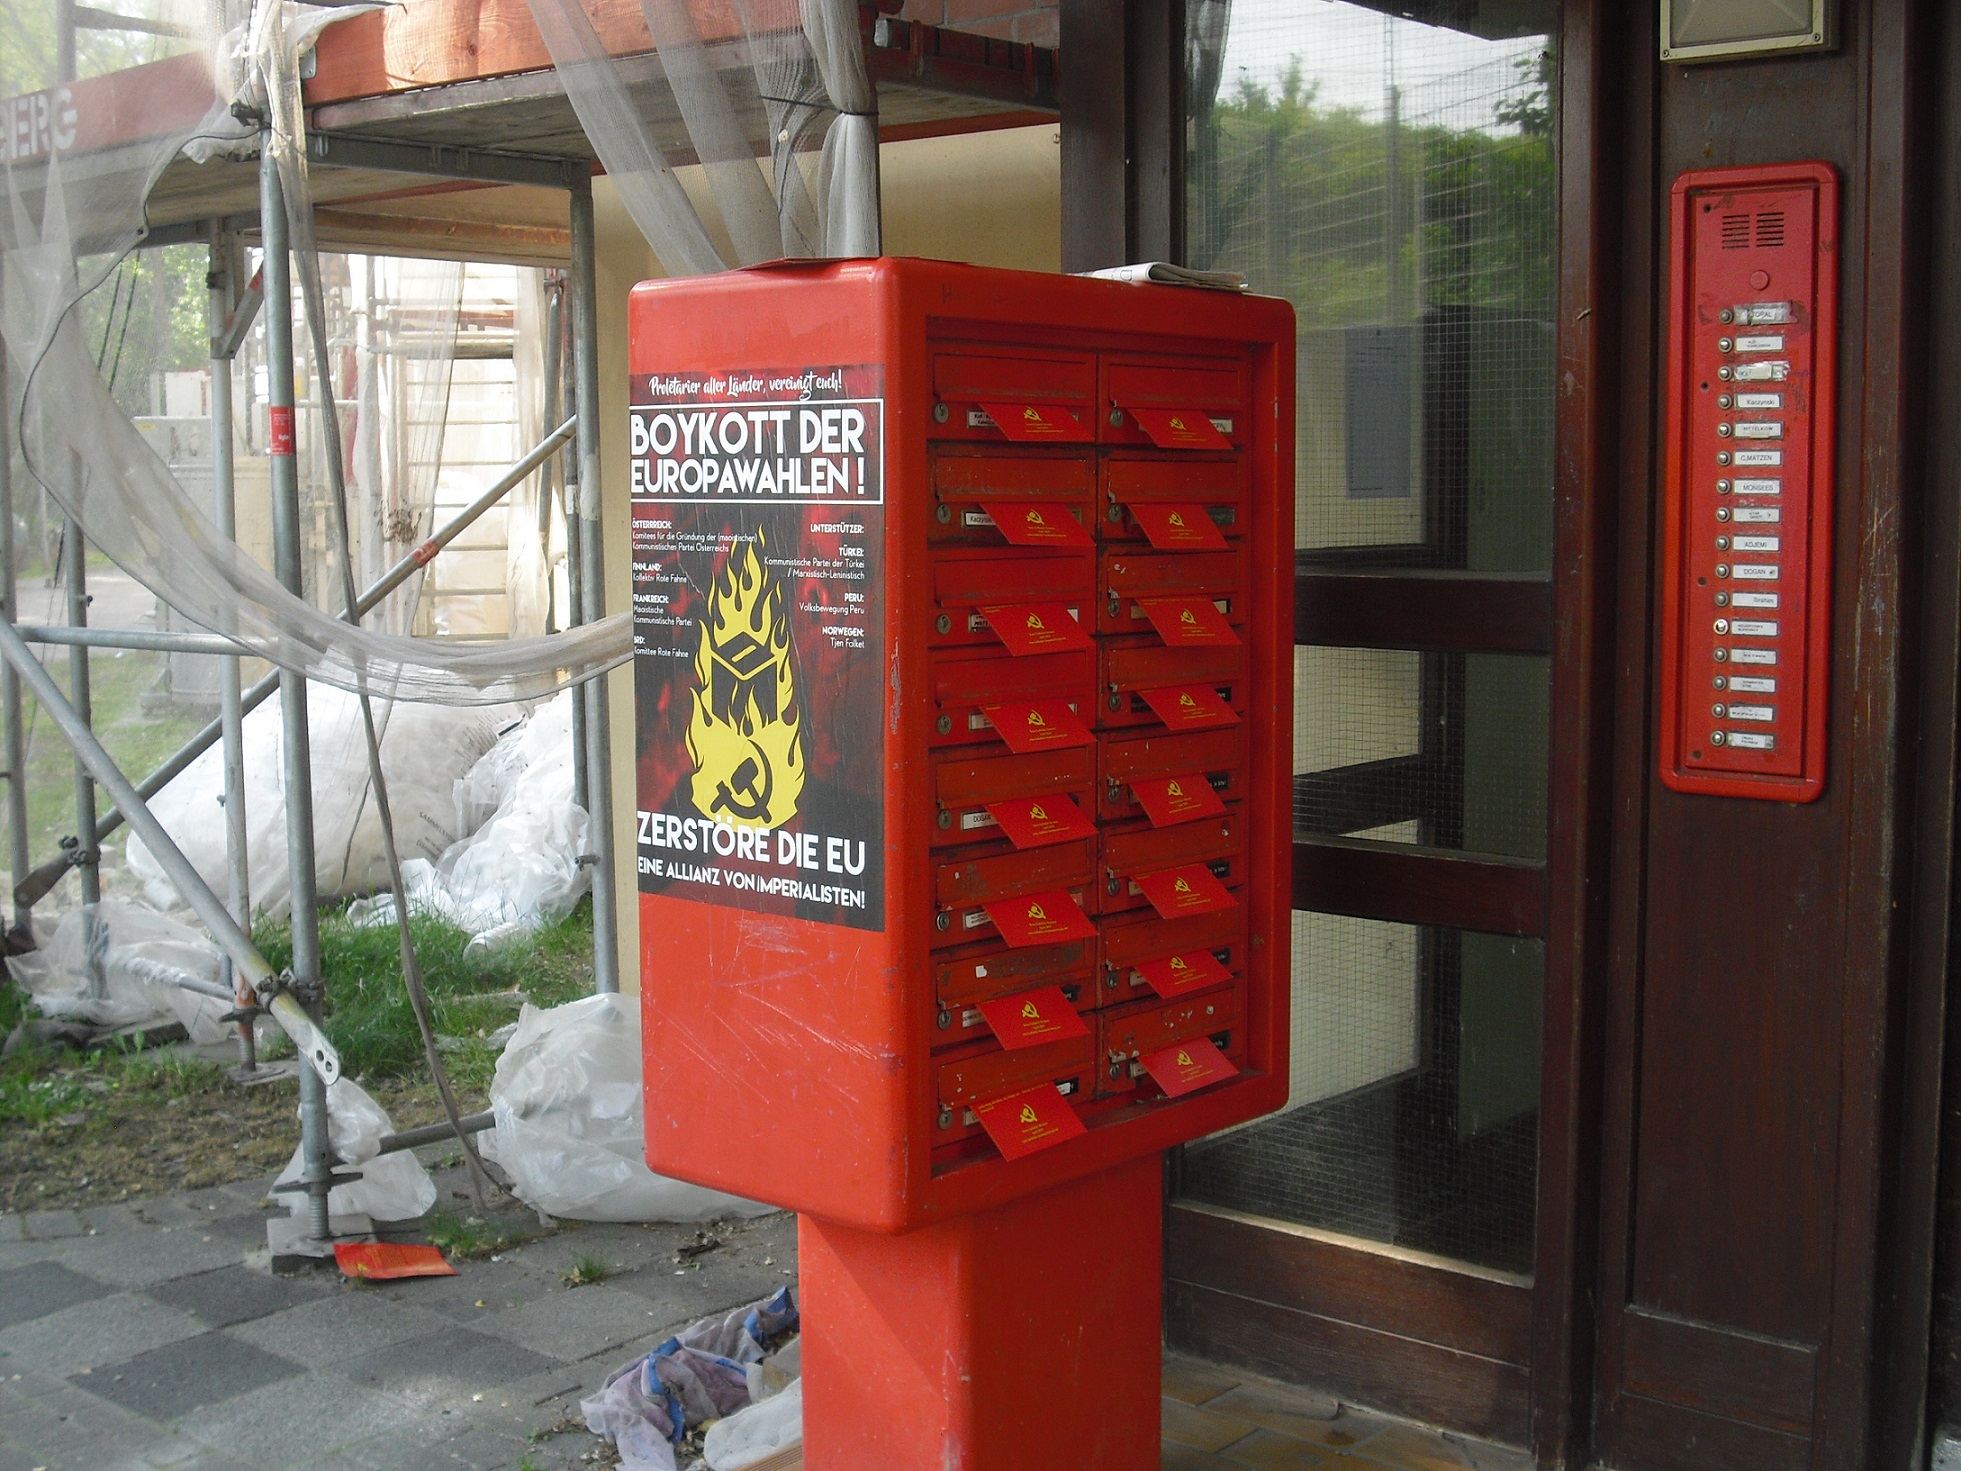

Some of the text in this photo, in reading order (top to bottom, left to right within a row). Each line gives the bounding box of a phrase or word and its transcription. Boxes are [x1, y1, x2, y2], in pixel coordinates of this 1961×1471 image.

[648, 368, 842, 401] Proletarier aller Länder, vereinigt euch!
[630, 409, 865, 456] BOYKOTT DER
[810, 522, 864, 533] UNTERSTÜTZER:
[666, 532, 675, 540] die
[676, 531, 705, 543] Gründung
[706, 532, 716, 541] der
[678, 541, 695, 552] Partei
[839, 544, 864, 557] TÜRKEI:
[764, 556, 864, 568] Kommunistische Partei der Türkei
[655, 574, 669, 582] Rote
[670, 574, 687, 583] Fahne
[633, 593, 670, 604] FRANKREICH:
[844, 592, 864, 603] PERU:
[799, 602, 865, 615] Volksbewegung Peru
[676, 616, 692, 626] Partei
[822, 626, 864, 637] NORWEGEN:
[830, 637, 864, 648] Tjen Folket
[657, 647, 671, 657] Rote
[672, 648, 689, 658] Fahne
[636, 811, 865, 876] ZERSTÖRE DIE EU
[638, 856, 866, 909] EINE ALLIANZ VON IMPERIALISTEN!
